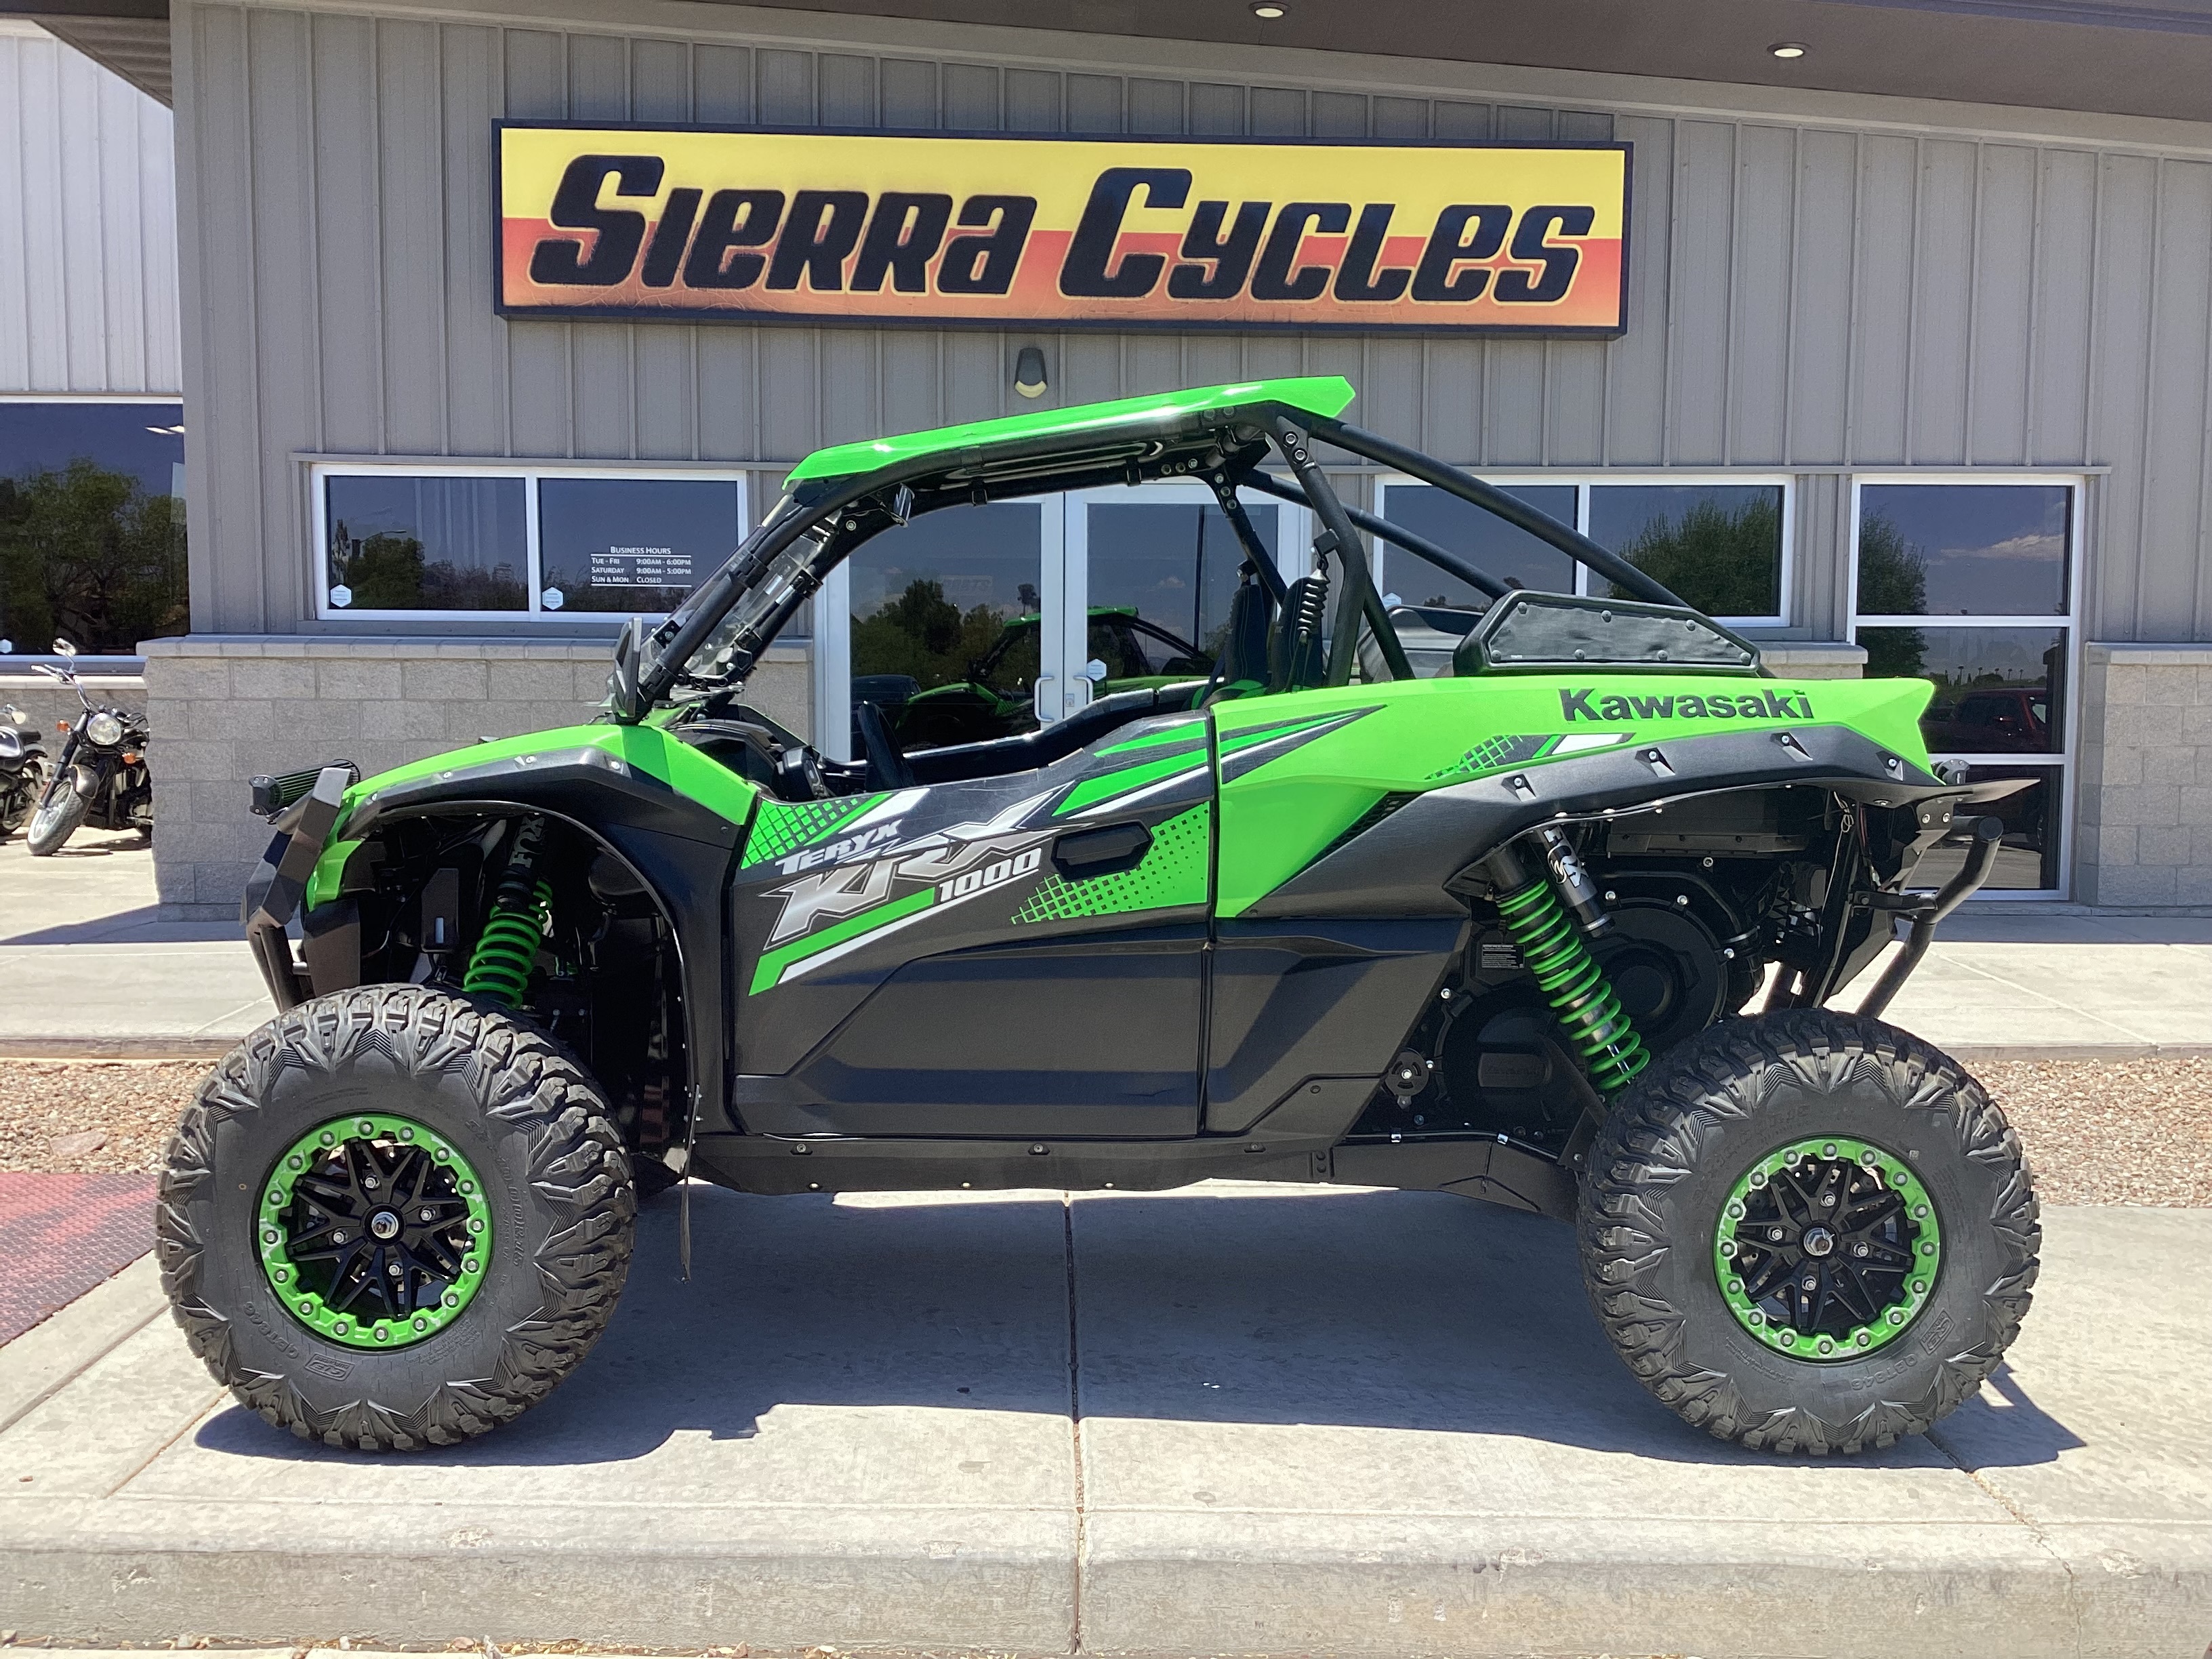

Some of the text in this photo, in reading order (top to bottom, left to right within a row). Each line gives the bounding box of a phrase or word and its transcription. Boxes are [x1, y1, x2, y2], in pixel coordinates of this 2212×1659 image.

[611, 546, 672, 555] BUSINESS HOURS
[1558, 688, 1816, 722] Kawasaki
[775, 819, 904, 876] TERYX
[939, 847, 1042, 903] 1000
